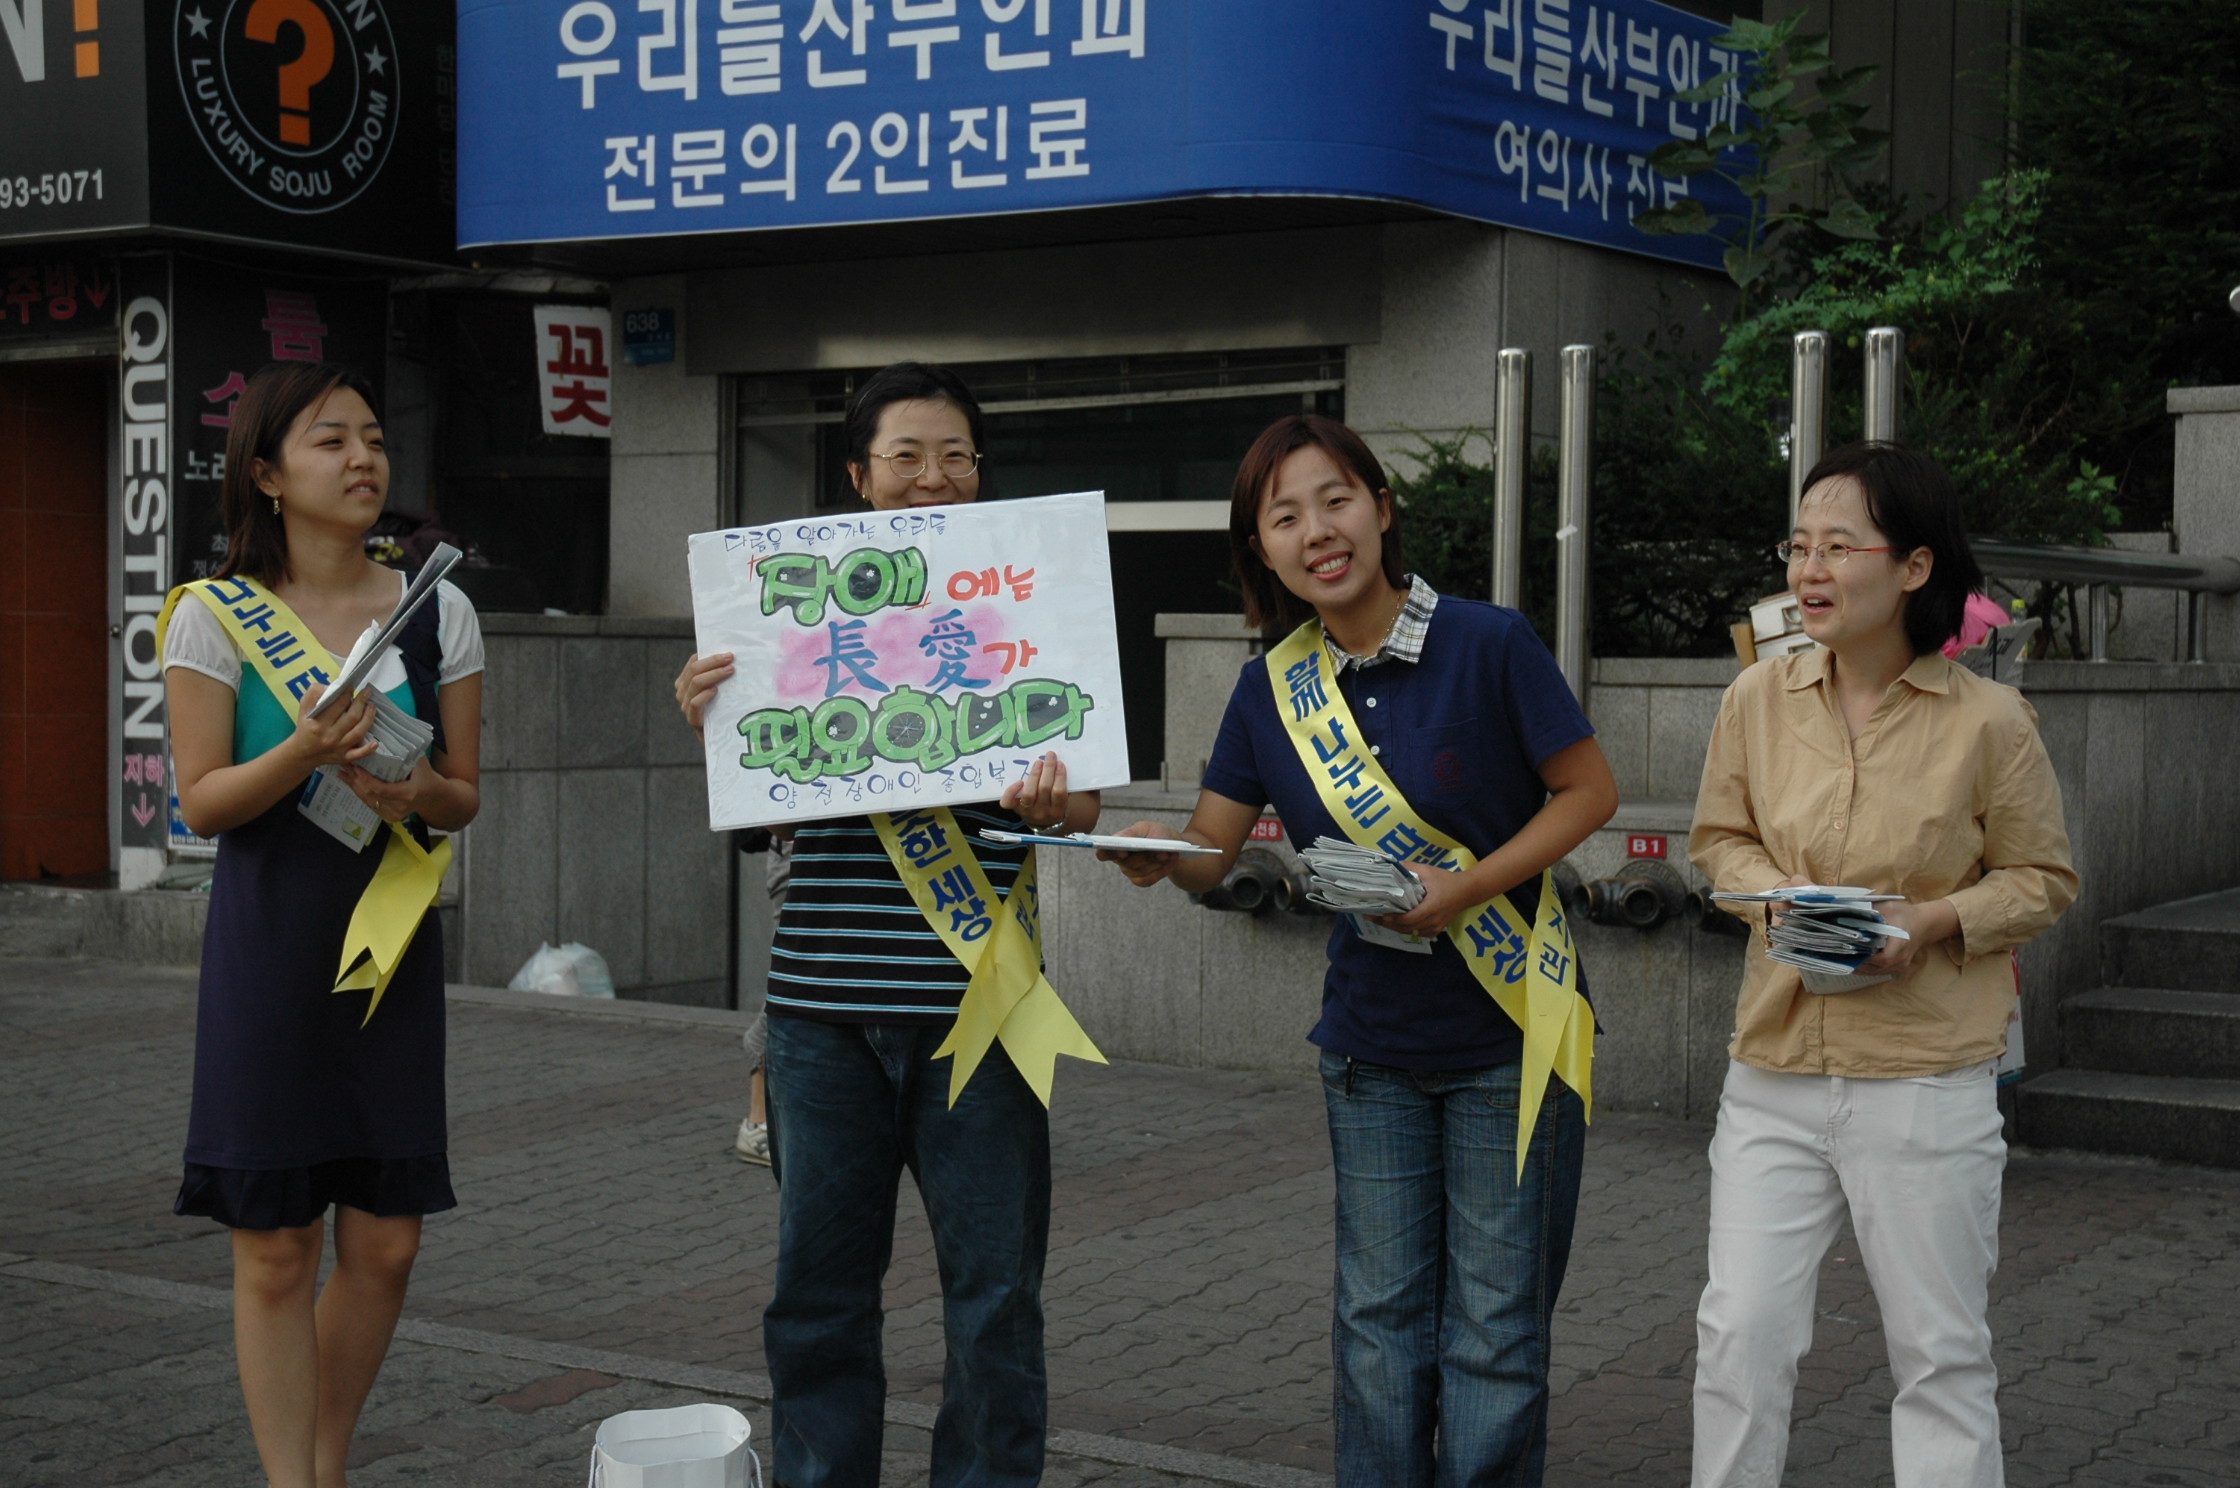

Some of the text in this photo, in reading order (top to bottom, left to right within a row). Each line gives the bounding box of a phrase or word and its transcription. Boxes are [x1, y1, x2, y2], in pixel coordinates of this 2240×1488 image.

[191, 58, 388, 198] LUXURY SOJU ROOM
[604, 98, 1090, 212] 전문의 2인진료
[1495, 120, 1612, 221] 여의사
[0, 169, 103, 209] 93-5071
[0, 262, 80, 324] 주방
[262, 289, 328, 362] 룸
[626, 312, 659, 333] 638
[547, 324, 611, 426] 꽃
[122, 295, 167, 739] QUESTION
[725, 513, 945, 552] 다름을 알아가는 우리들
[205, 576, 306, 669] 나누는
[124, 754, 164, 786] 지하
[737, 678, 1094, 783] 필요합니다
[1284, 650, 1329, 723] 함께
[1311, 717, 1392, 829] 나누는
[1465, 904, 1528, 984] 세상
[1632, 838, 1659, 854] B1
[928, 864, 992, 942] 세상
[1539, 882, 1570, 986] 지관
